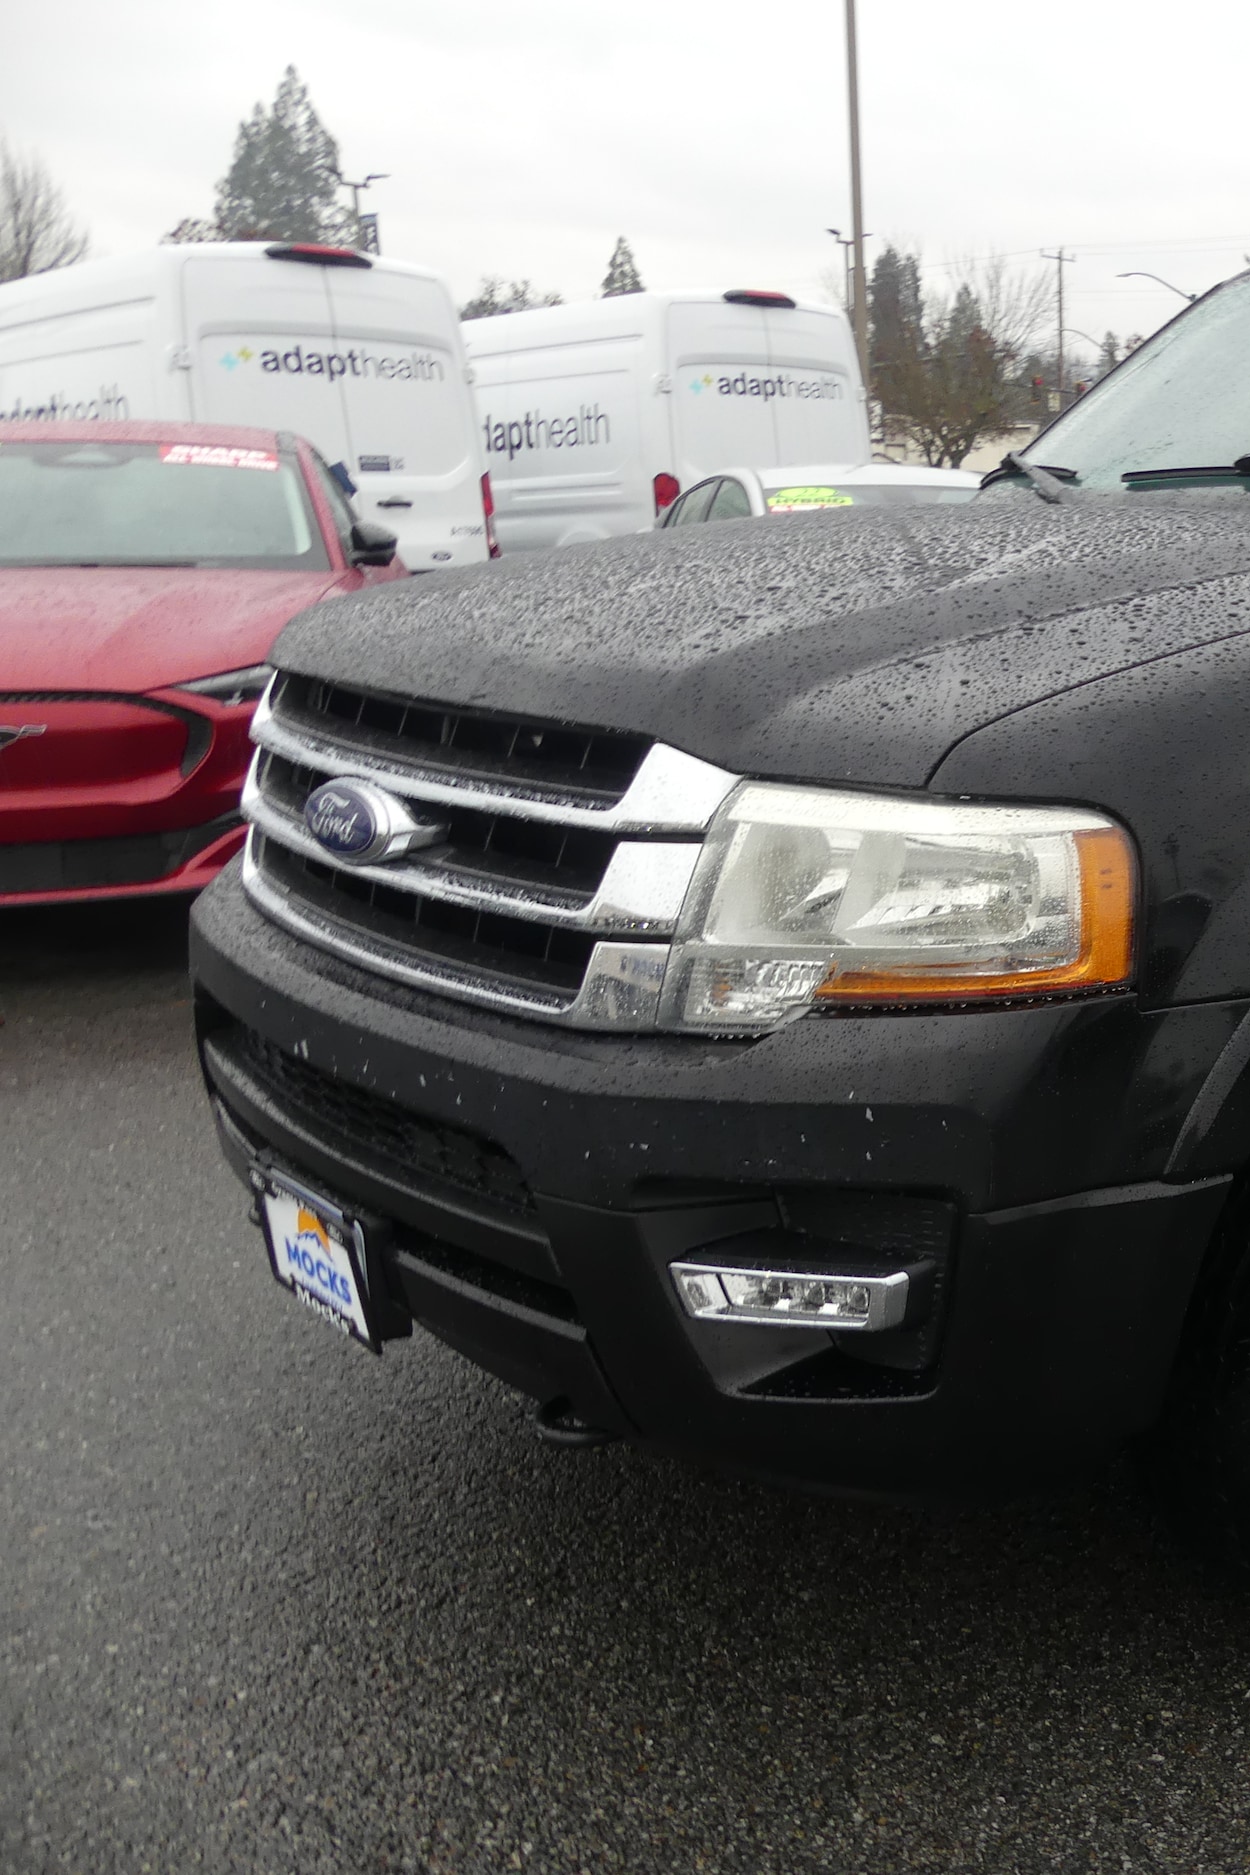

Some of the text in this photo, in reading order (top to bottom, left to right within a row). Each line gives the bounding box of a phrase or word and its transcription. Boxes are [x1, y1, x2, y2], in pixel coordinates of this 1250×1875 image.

[261, 344, 445, 382] adapthealth
[717, 371, 842, 402] adapthealth
[312, 791, 358, 844] Ford
[285, 1236, 353, 1305] MOCKS
